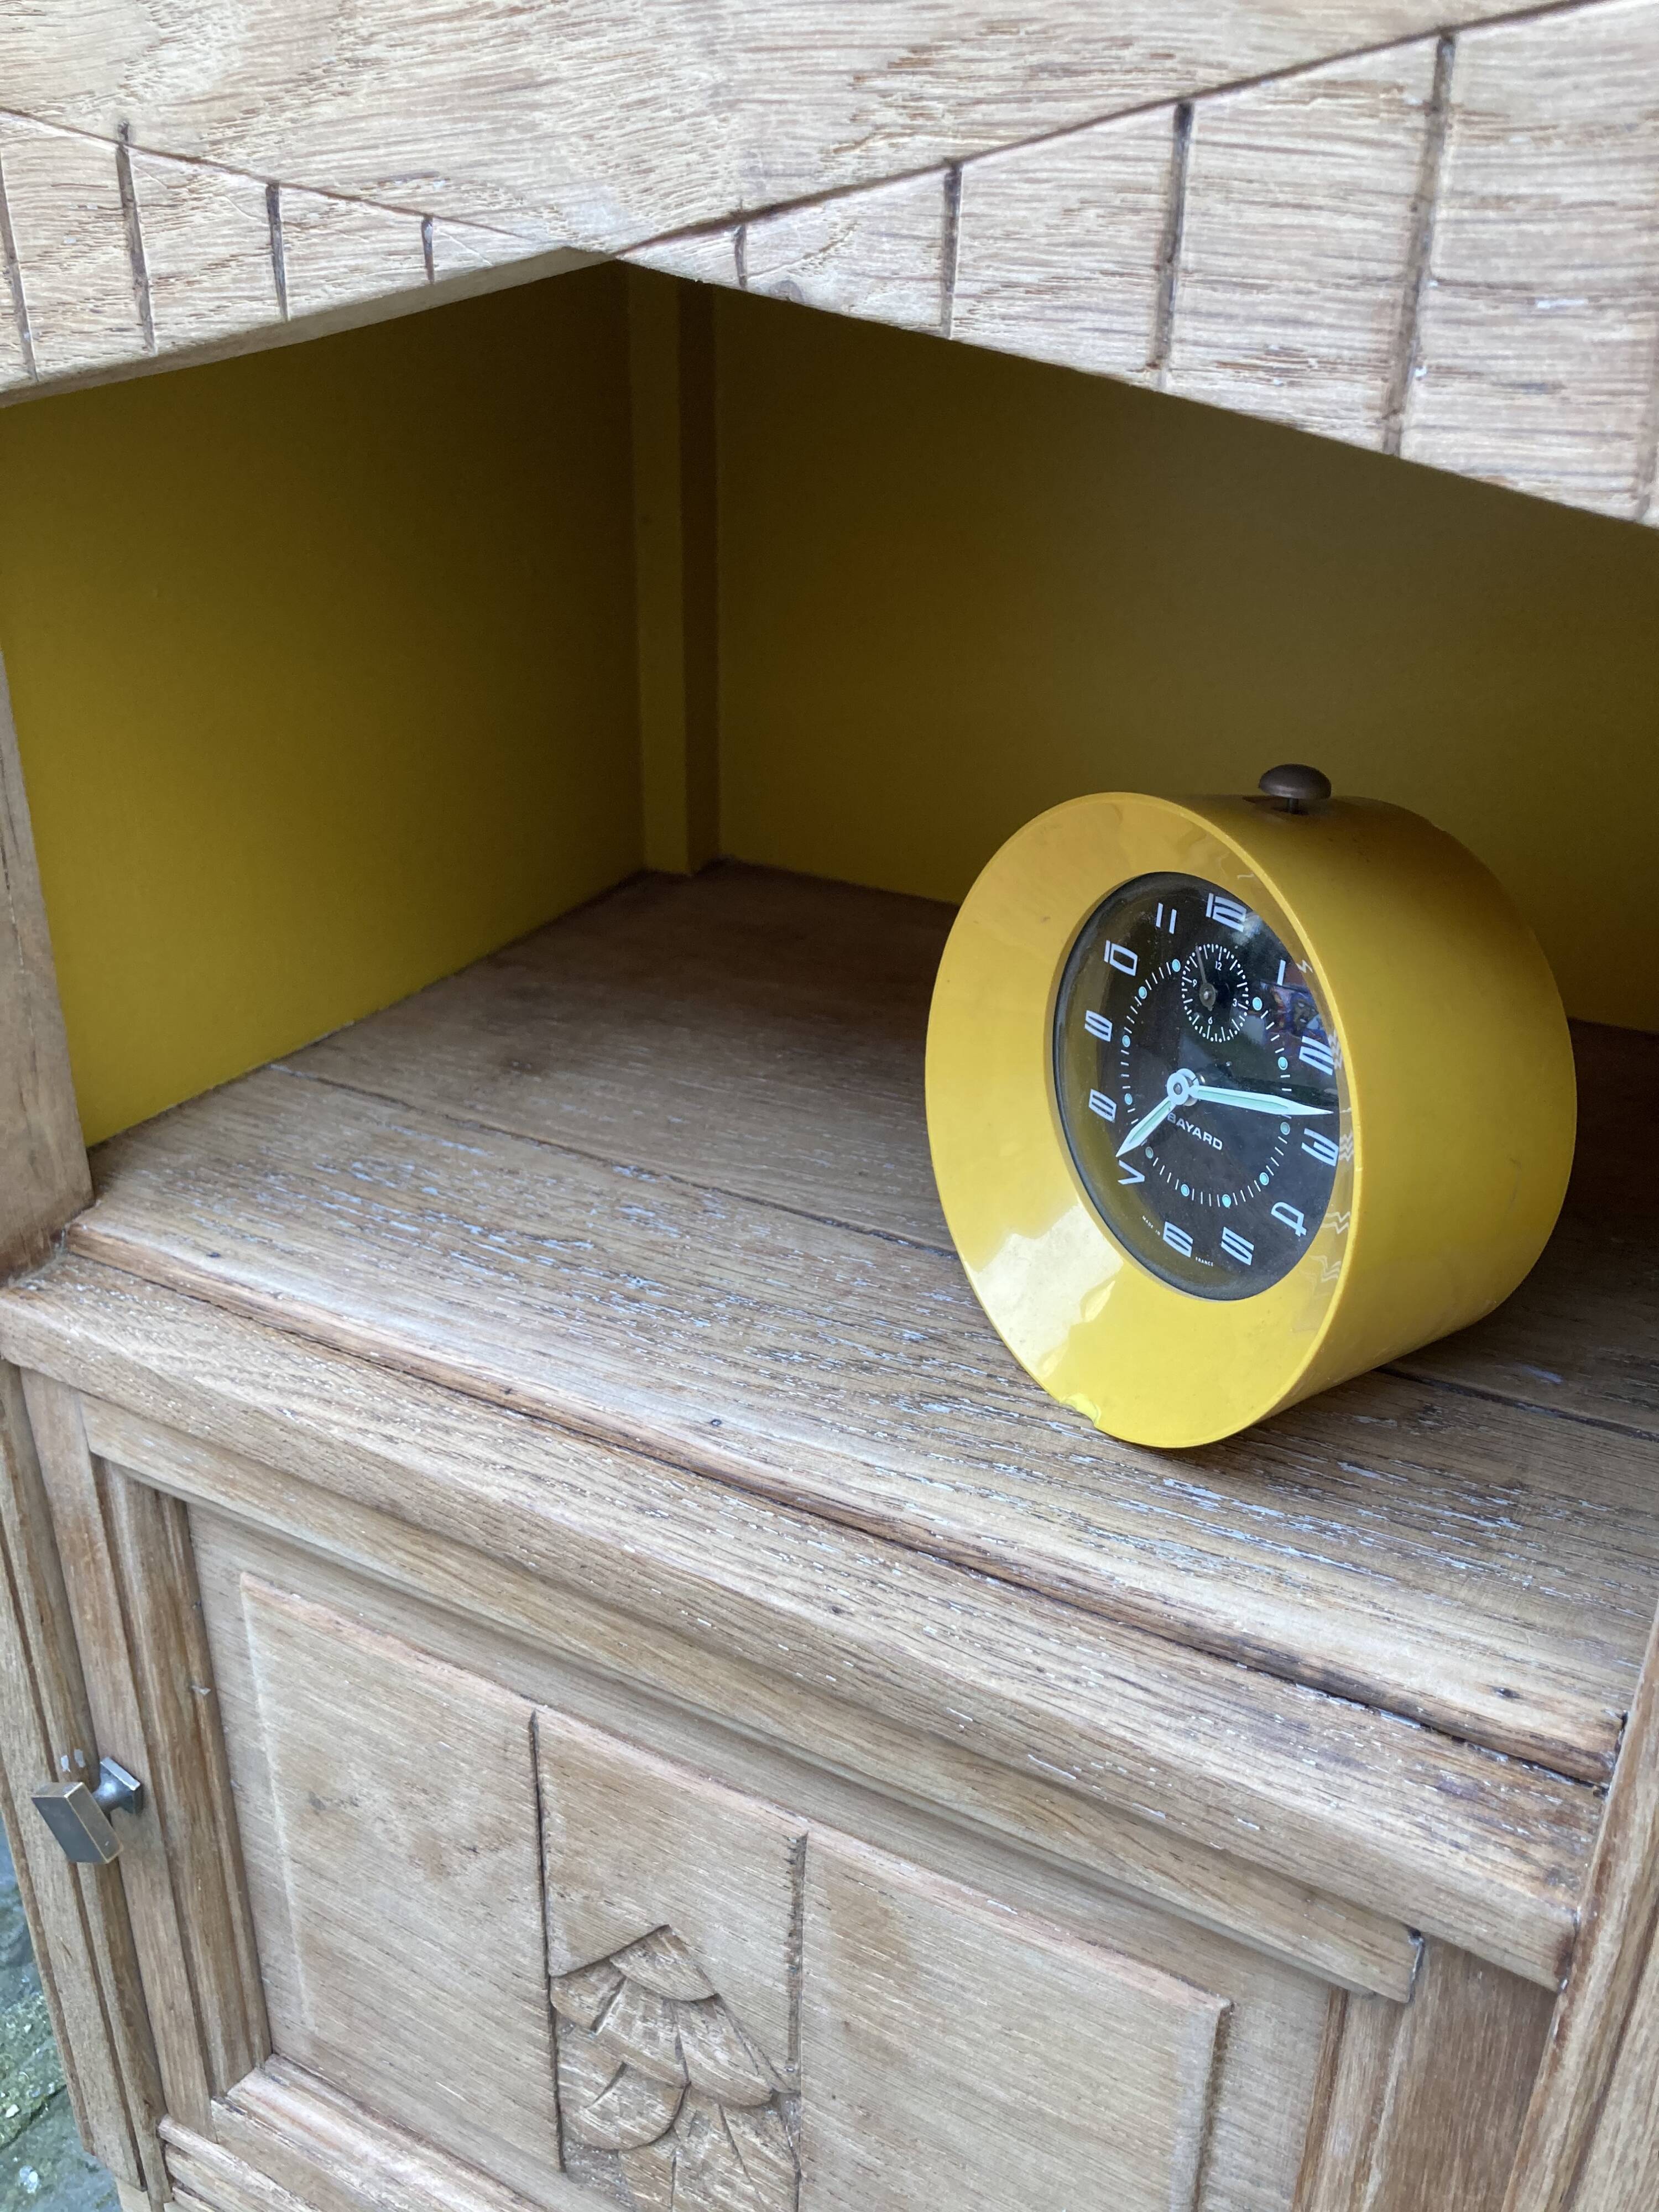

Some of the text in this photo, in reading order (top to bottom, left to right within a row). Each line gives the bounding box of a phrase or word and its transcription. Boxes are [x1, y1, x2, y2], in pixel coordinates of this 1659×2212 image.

[1156, 903, 1177, 933] 11
[1206, 893, 1246, 931] 12
[1104, 940, 1138, 975] 10
[1215, 961, 1222, 971] 12
[1192, 979, 1197, 987] 9
[1233, 998, 1238, 1006] 3
[1084, 1010, 1112, 1041] 9
[1299, 1036, 1333, 1075] 2
[1088, 1089, 1117, 1123] 8
[1167, 1112, 1223, 1150] BAYARD
[1301, 1128, 1338, 1166] 3
[1118, 1160, 1145, 1185] 7
[1271, 1202, 1307, 1237] 4
[1162, 1221, 1193, 1258] 6
[1221, 1227, 1254, 1265] 5
[1196, 1256, 1214, 1267] FRANCE
